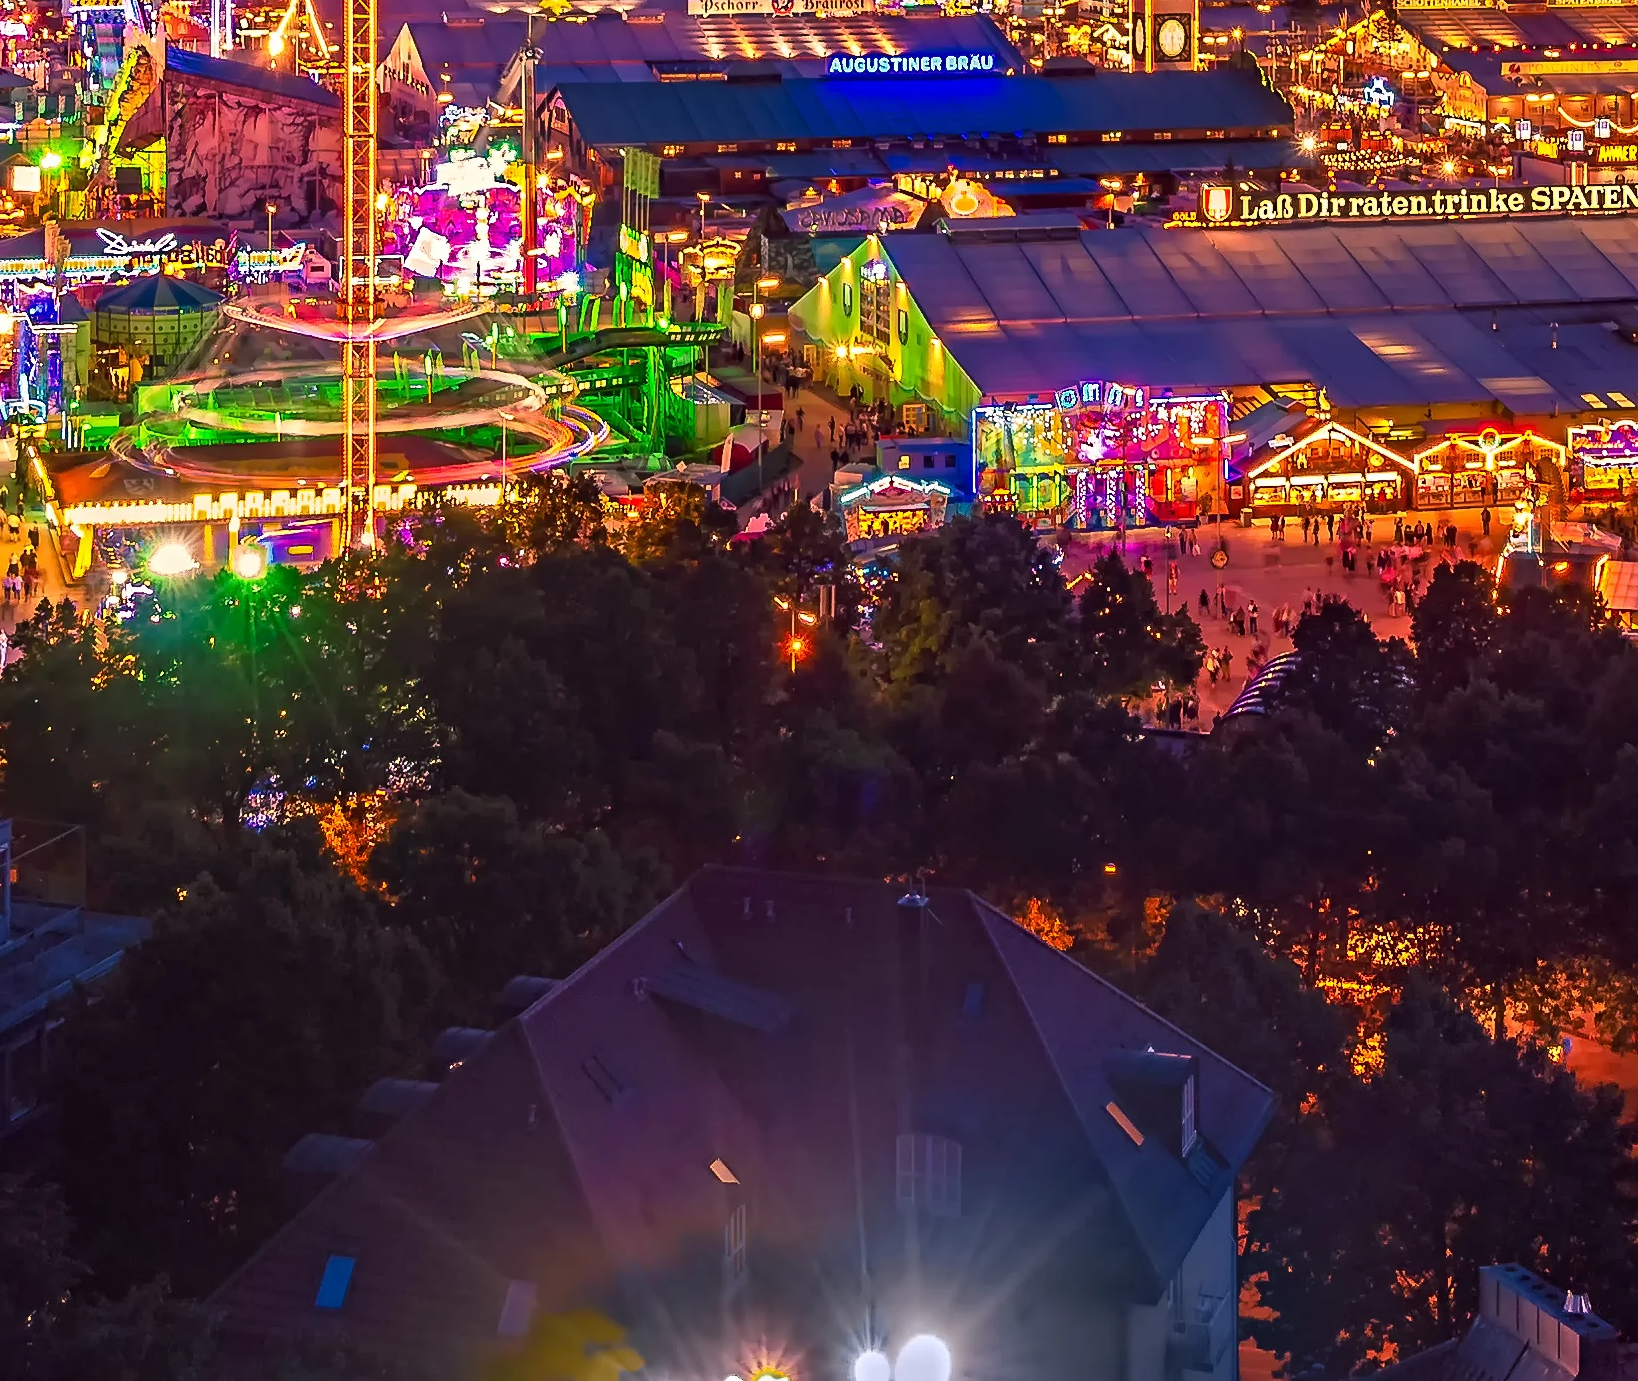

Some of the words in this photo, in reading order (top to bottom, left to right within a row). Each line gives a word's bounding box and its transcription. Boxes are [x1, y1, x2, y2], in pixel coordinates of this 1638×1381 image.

[830, 56, 942, 73] AUGUSTINER
[946, 53, 994, 71] BRÄU
[1597, 144, 1638, 163] AMMER
[1239, 193, 1294, 220] Laß
[1297, 191, 1345, 218] Dir
